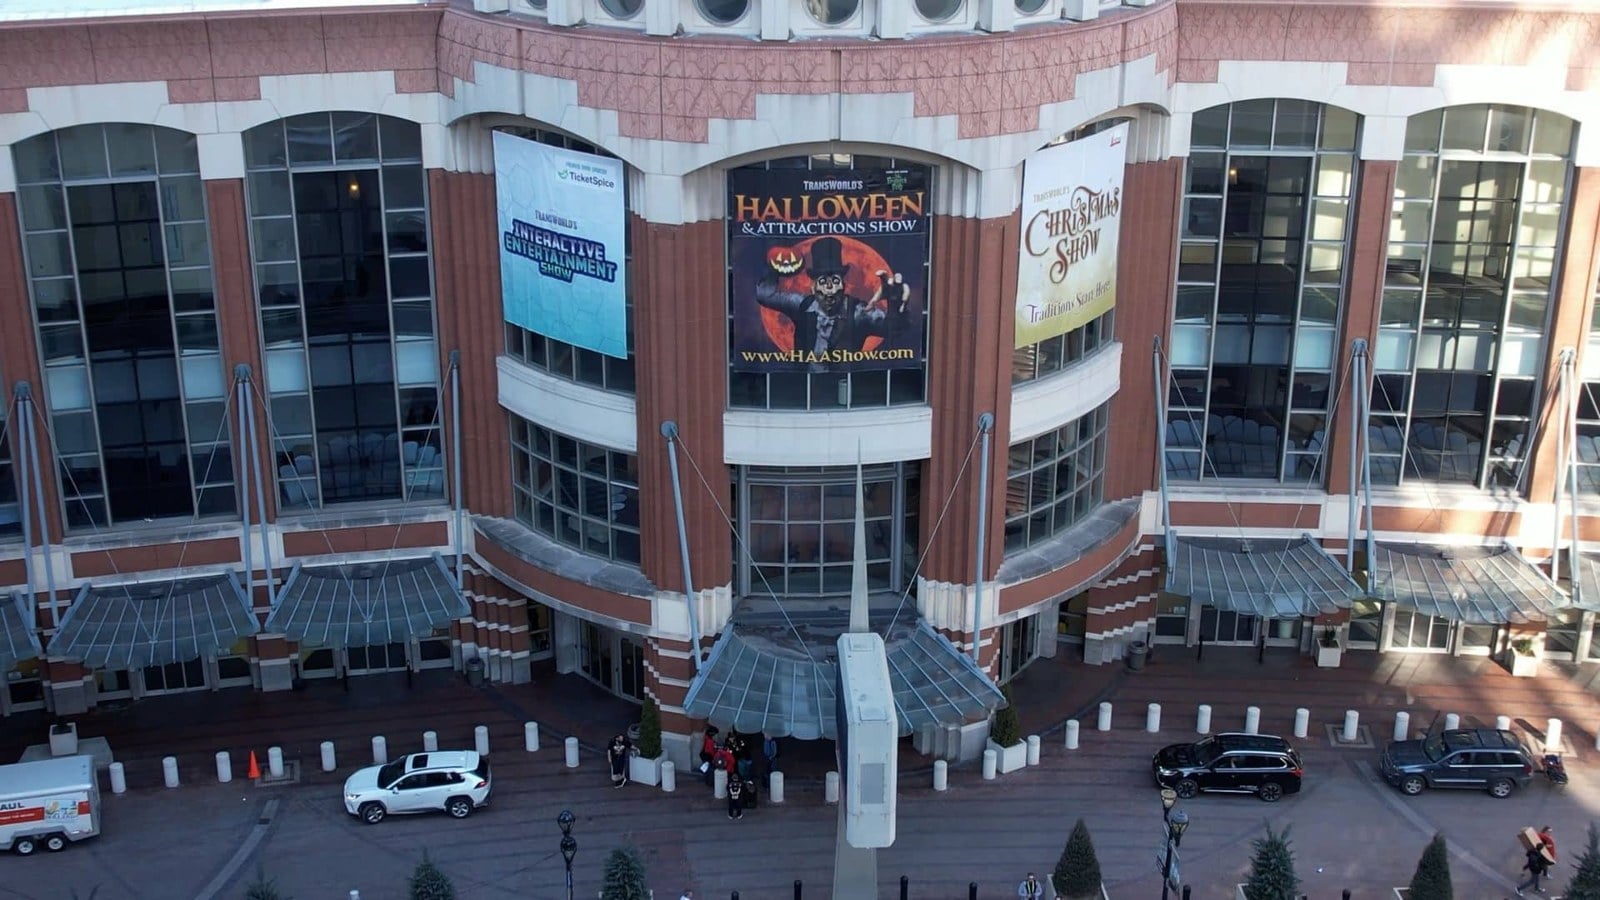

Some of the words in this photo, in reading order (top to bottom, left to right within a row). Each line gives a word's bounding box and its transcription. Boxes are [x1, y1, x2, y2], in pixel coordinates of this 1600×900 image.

[570, 171, 615, 188] TicketSpice
[803, 180, 863, 190] TRANSWORLD'S
[736, 192, 925, 221] HALLOWEEN
[741, 223, 759, 237] &
[758, 221, 866, 234] ATTRACTIONS
[870, 219, 917, 232] SHOW
[512, 220, 604, 262] INTERACTIVE
[505, 233, 616, 281] ENTERTAINMENT
[1049, 228, 1101, 285] SHOW
[540, 261, 572, 280] SHOW
[1025, 303, 1075, 324] Traditions
[741, 348, 914, 363] www.HAAShow.com
